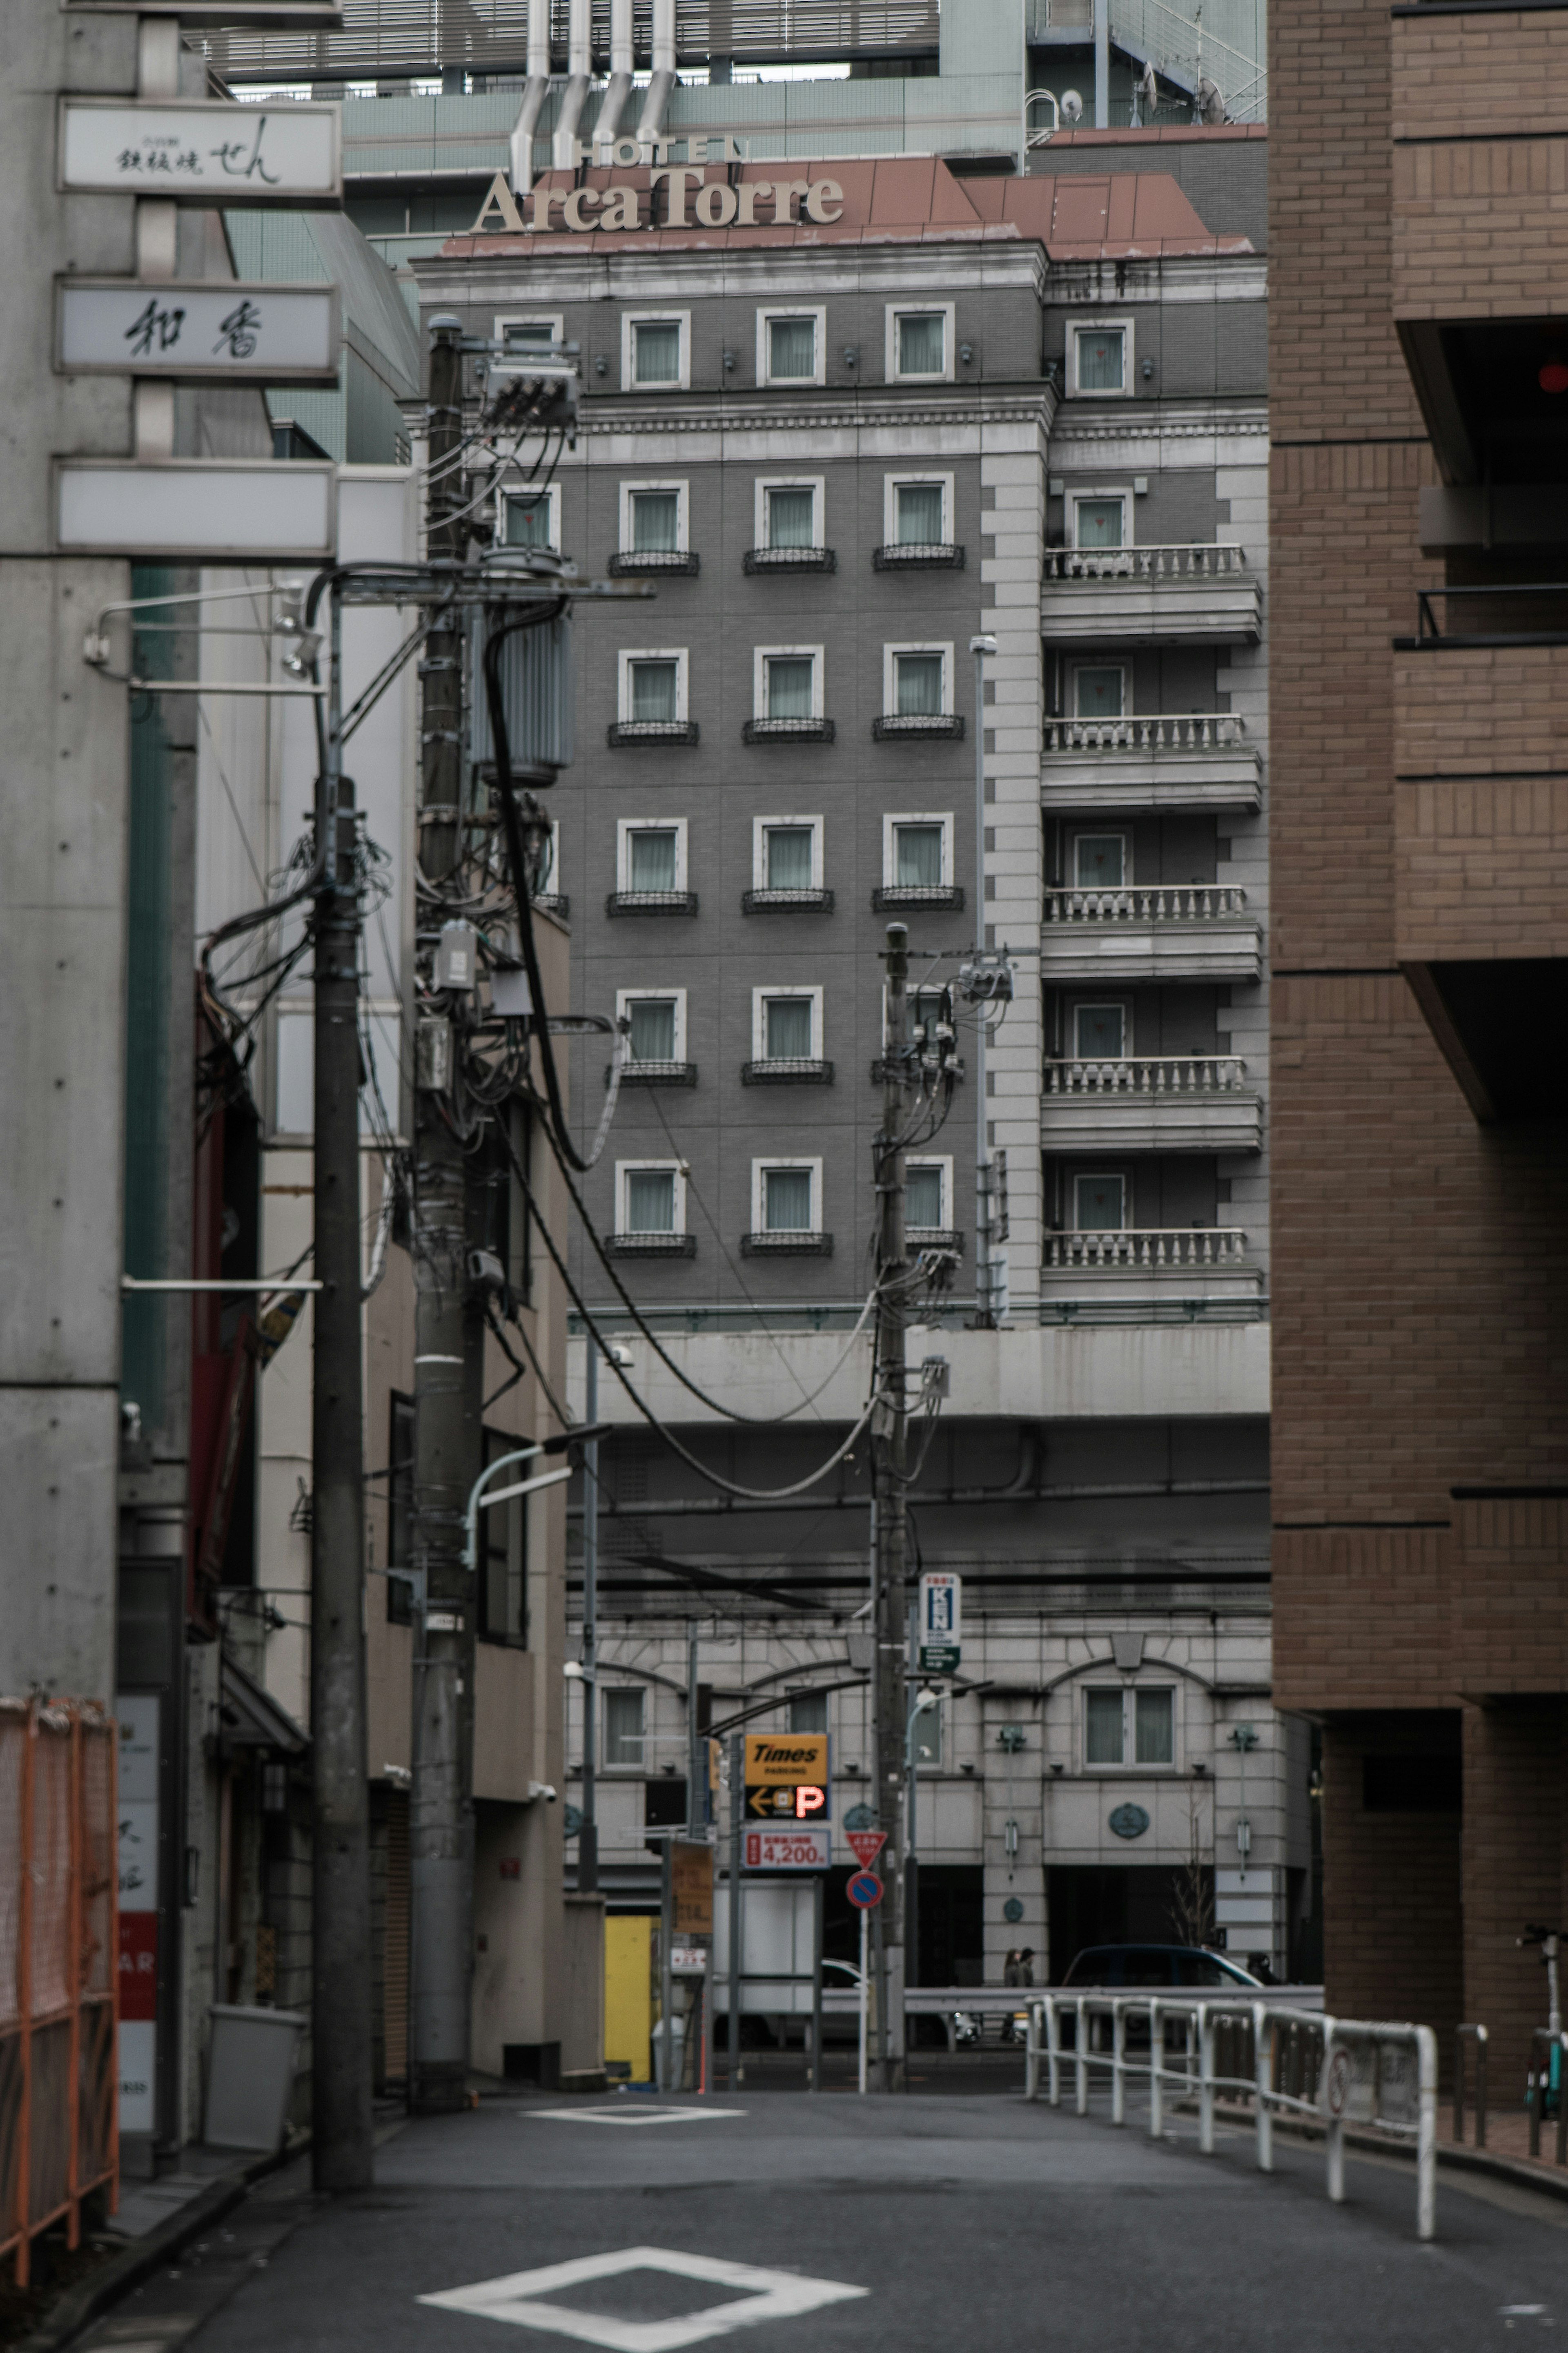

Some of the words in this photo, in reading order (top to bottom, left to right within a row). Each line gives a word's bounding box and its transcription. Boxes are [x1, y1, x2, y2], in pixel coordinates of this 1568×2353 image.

[573, 136, 742, 169] HOTEL
[933, 1588, 949, 1629] KEN
[754, 1744, 818, 1762] Times
[796, 1786, 825, 1818] P
